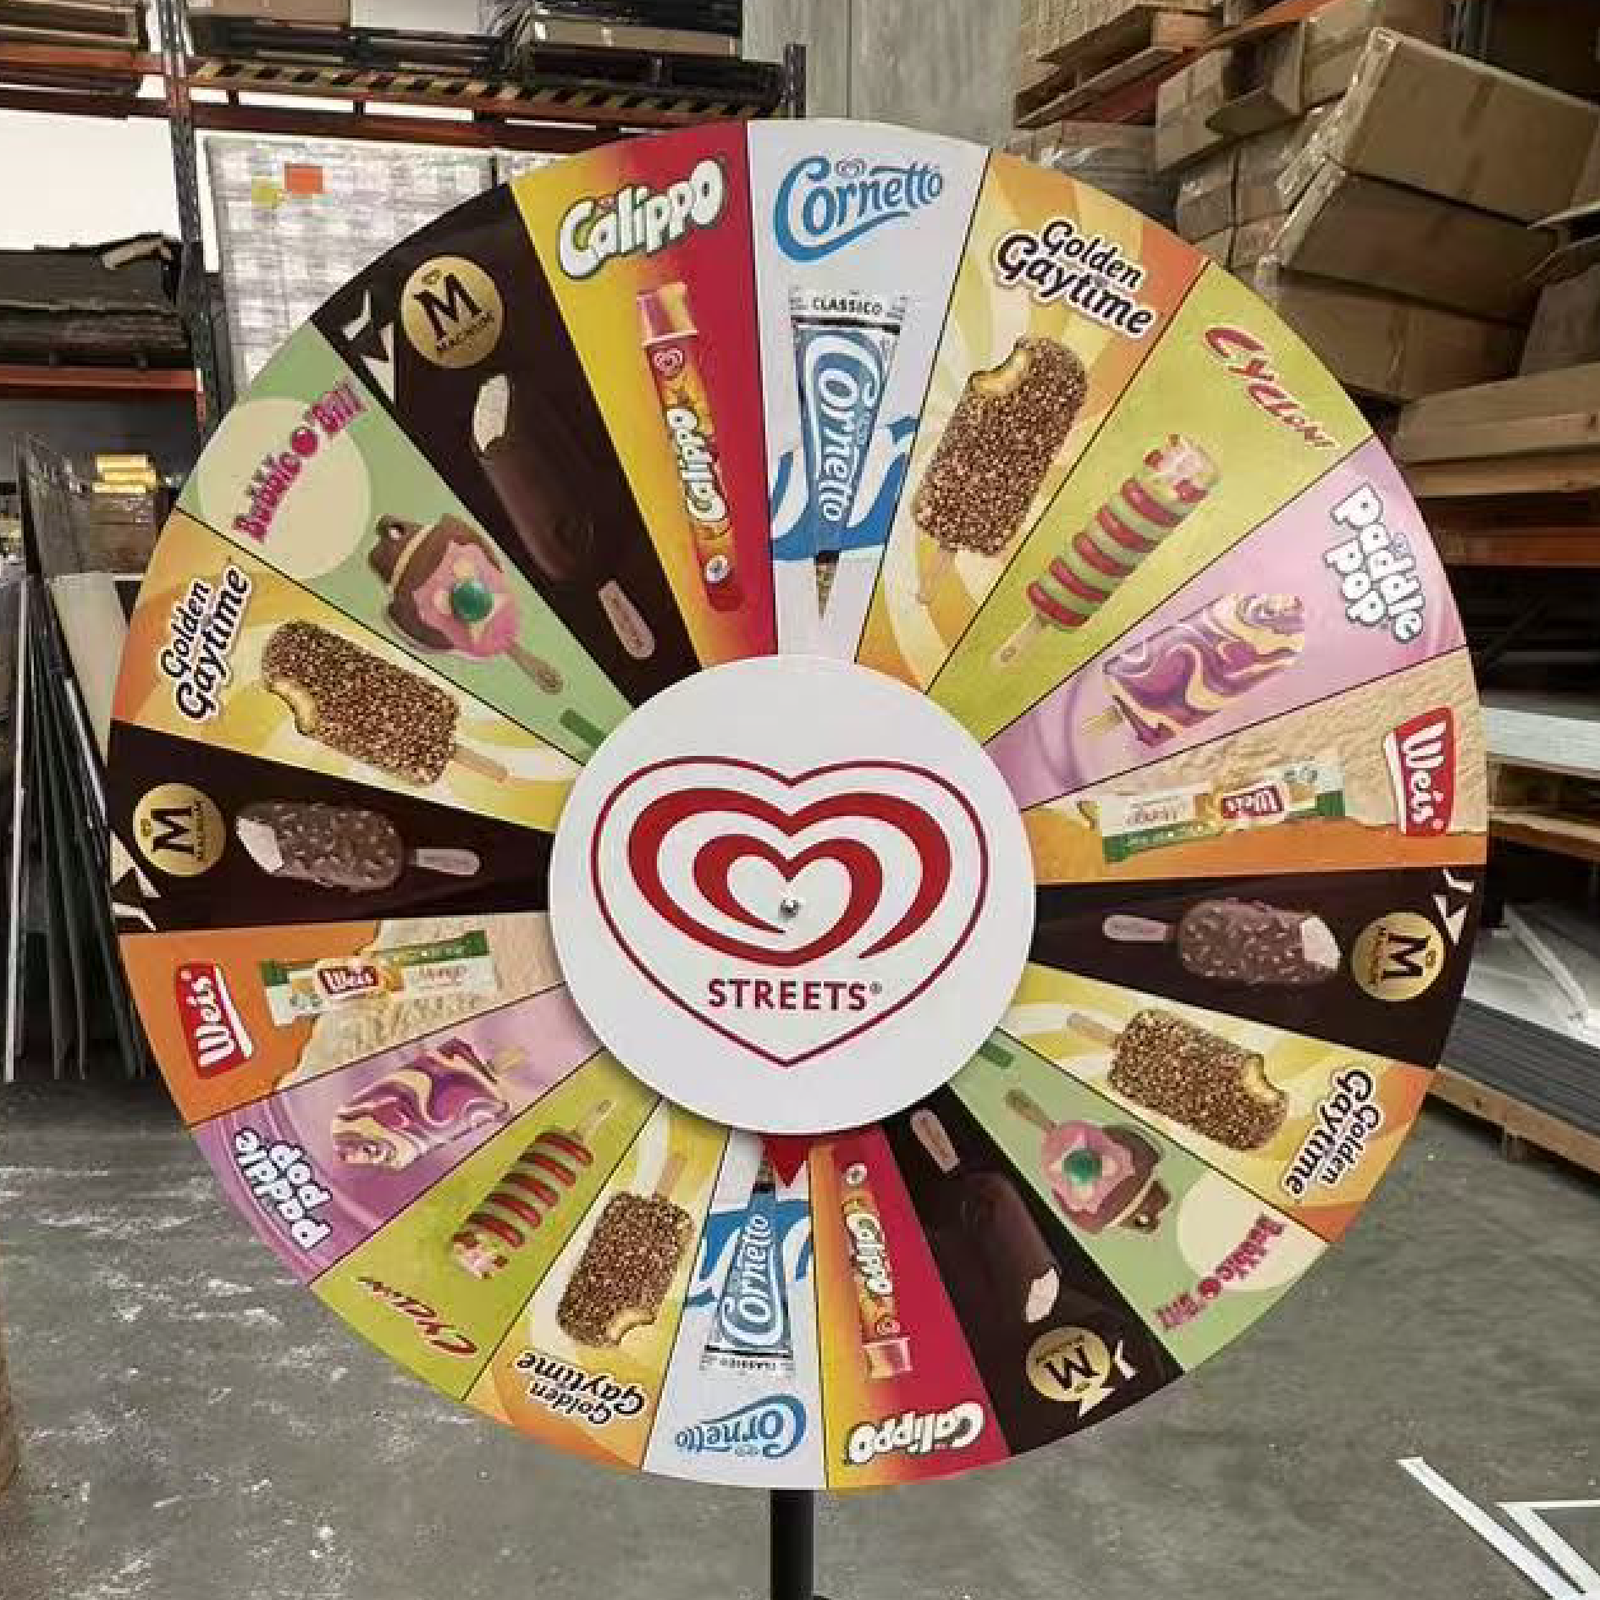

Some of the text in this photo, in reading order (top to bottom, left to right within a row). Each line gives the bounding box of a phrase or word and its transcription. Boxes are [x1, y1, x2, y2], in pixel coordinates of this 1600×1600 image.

[556, 157, 725, 279] Calippo
[772, 155, 944, 263] Cornetto
[996, 232, 1154, 335] Gaytime
[1042, 219, 1142, 289] Golden
[412, 271, 483, 341] M
[664, 404, 729, 524] Calippo
[803, 334, 883, 523] Cornetto
[160, 581, 211, 679] Golden
[175, 568, 249, 719] Gaytime
[150, 805, 195, 855] M
[708, 978, 867, 1011] STREETS
[1381, 932, 1431, 982] M
[1285, 1070, 1373, 1195] Gaytime
[1321, 1104, 1380, 1185] Golden
[719, 1212, 786, 1348] Cornetto
[845, 1212, 893, 1297] Calippo
[516, 1351, 645, 1415] Gaytime
[529, 1382, 612, 1425] Golden
[1043, 1344, 1101, 1390] M
[674, 1392, 807, 1460] Cornetto
[846, 1401, 985, 1464] Calippo
